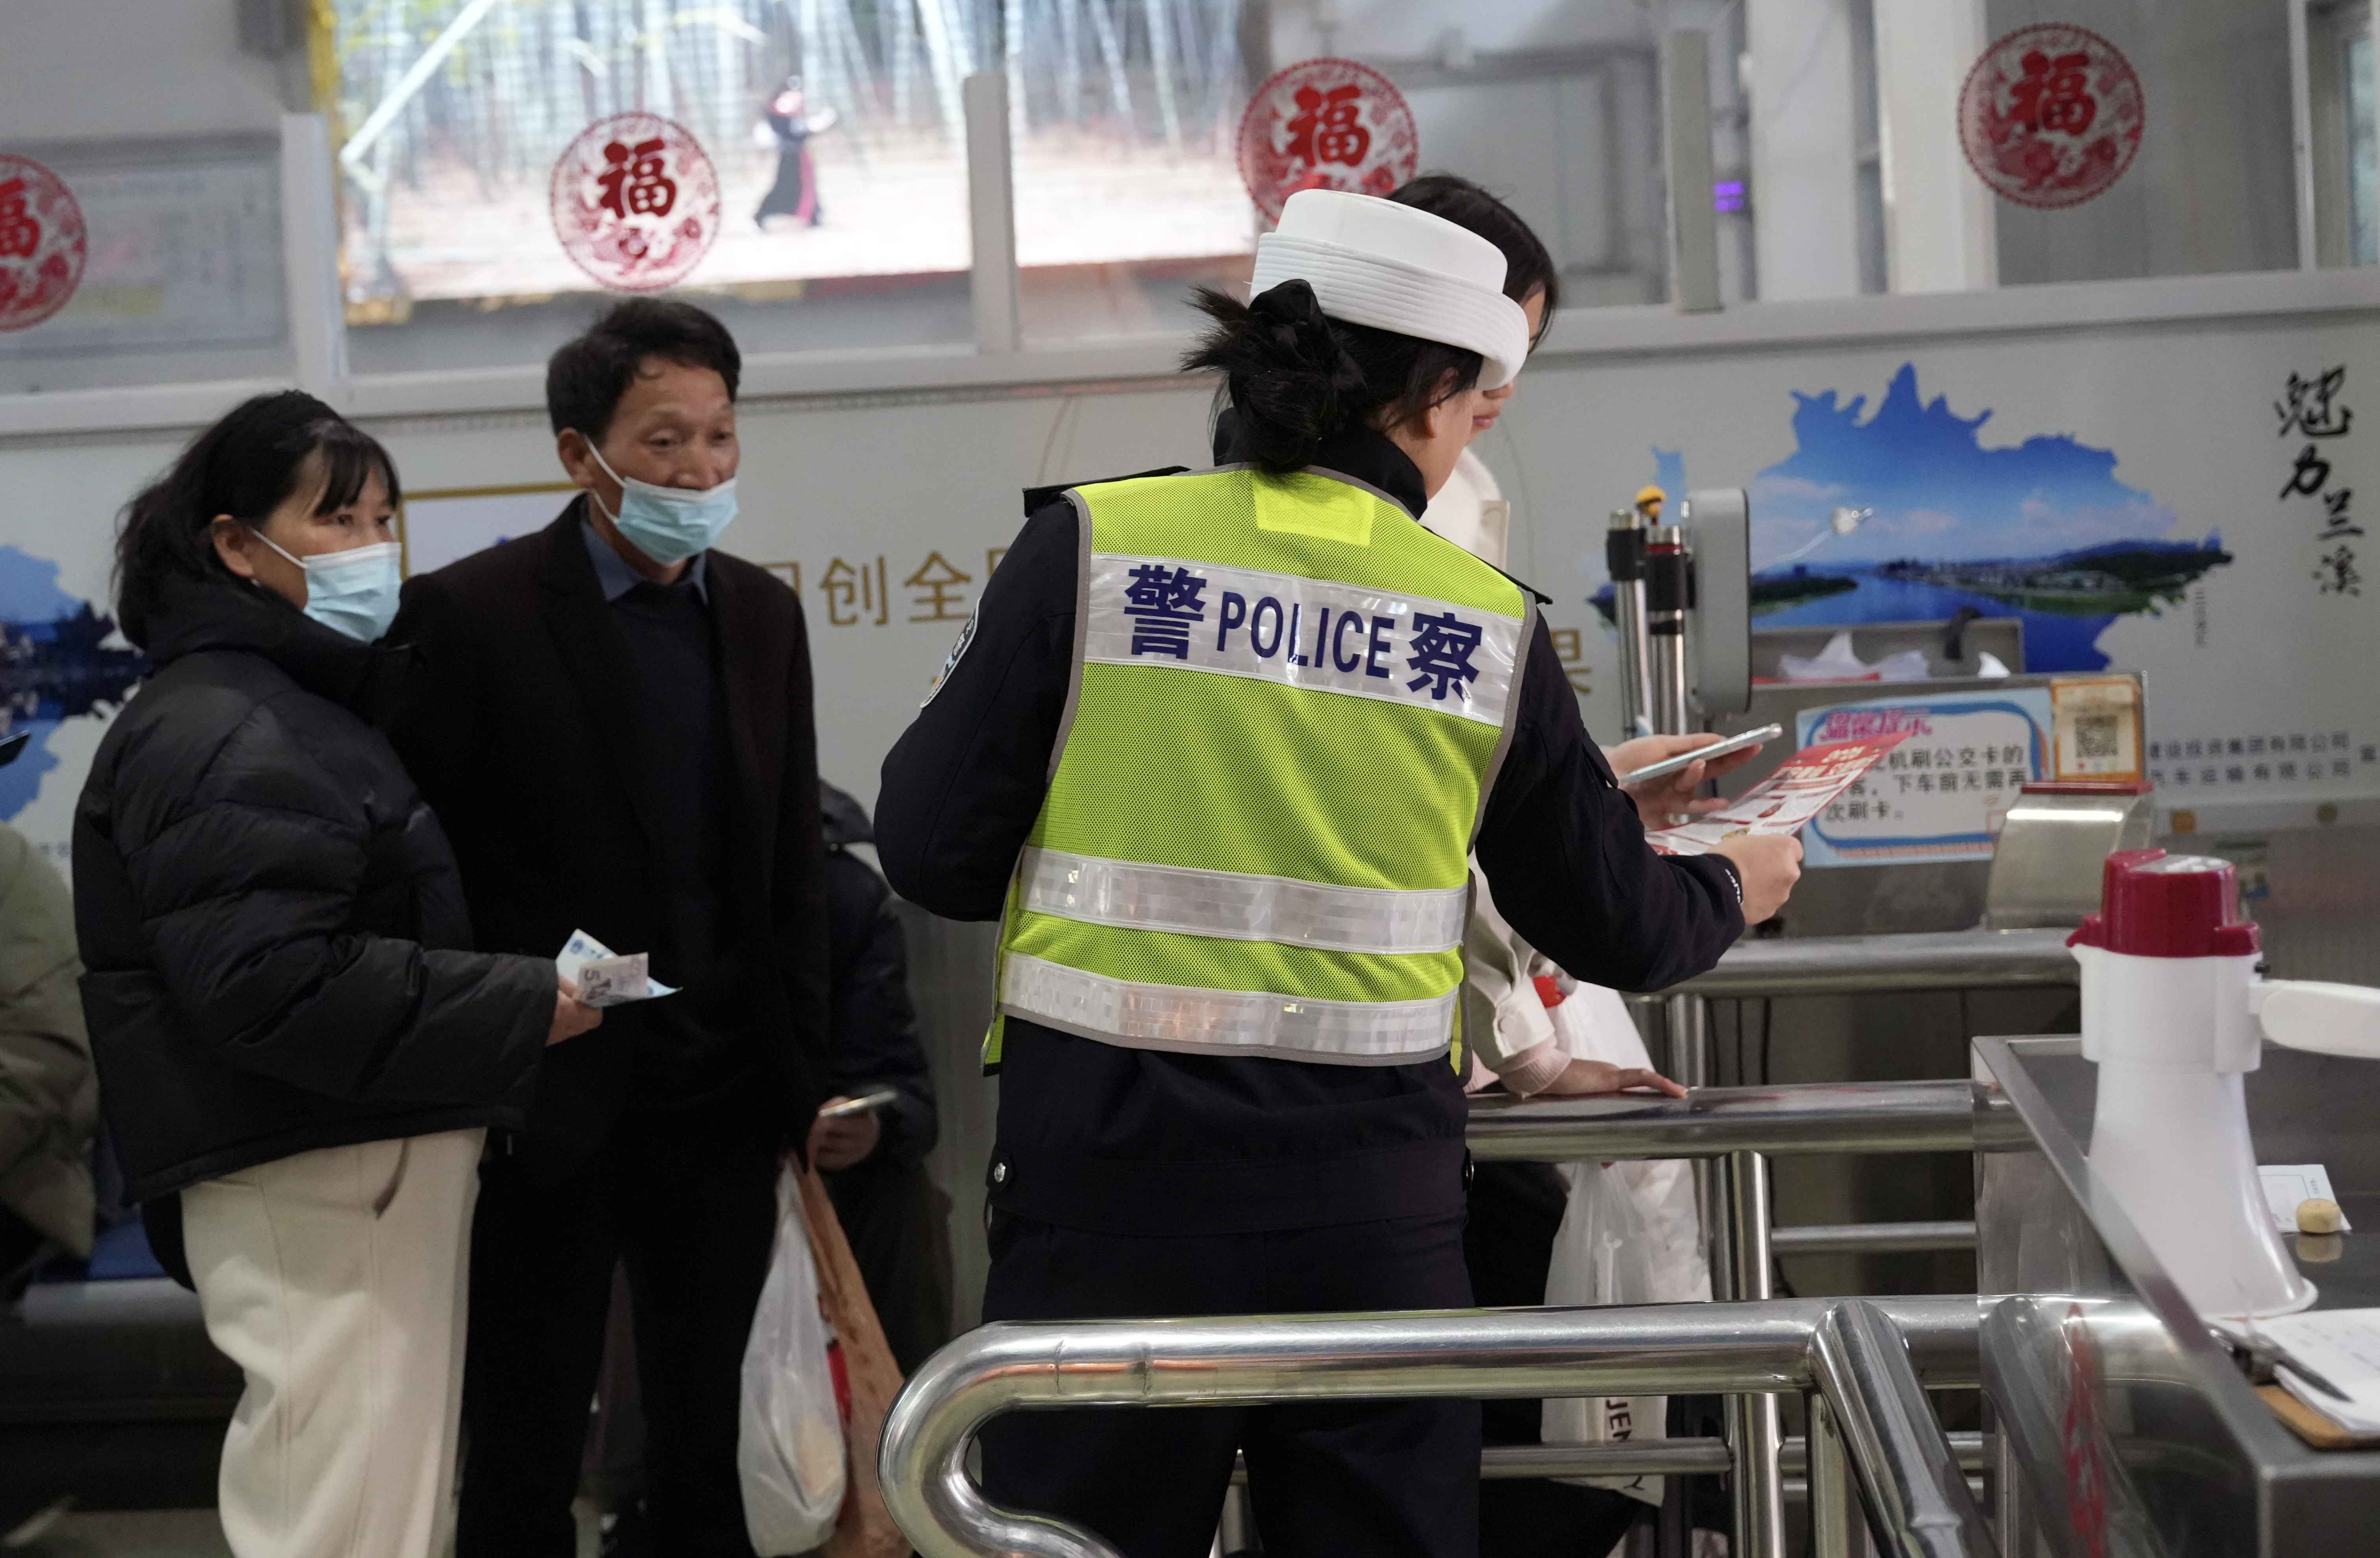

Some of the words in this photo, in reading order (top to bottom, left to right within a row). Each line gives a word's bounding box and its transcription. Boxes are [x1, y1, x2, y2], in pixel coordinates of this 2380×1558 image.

[1287, 84, 1370, 167] 福
[2009, 50, 2097, 136] 福
[598, 138, 677, 219] 福
[1124, 564, 1207, 660] 警
[1216, 591, 1395, 679] POLICE
[1406, 612, 1482, 701] 察
[1871, 746, 2023, 771] 机刷公交卡的
